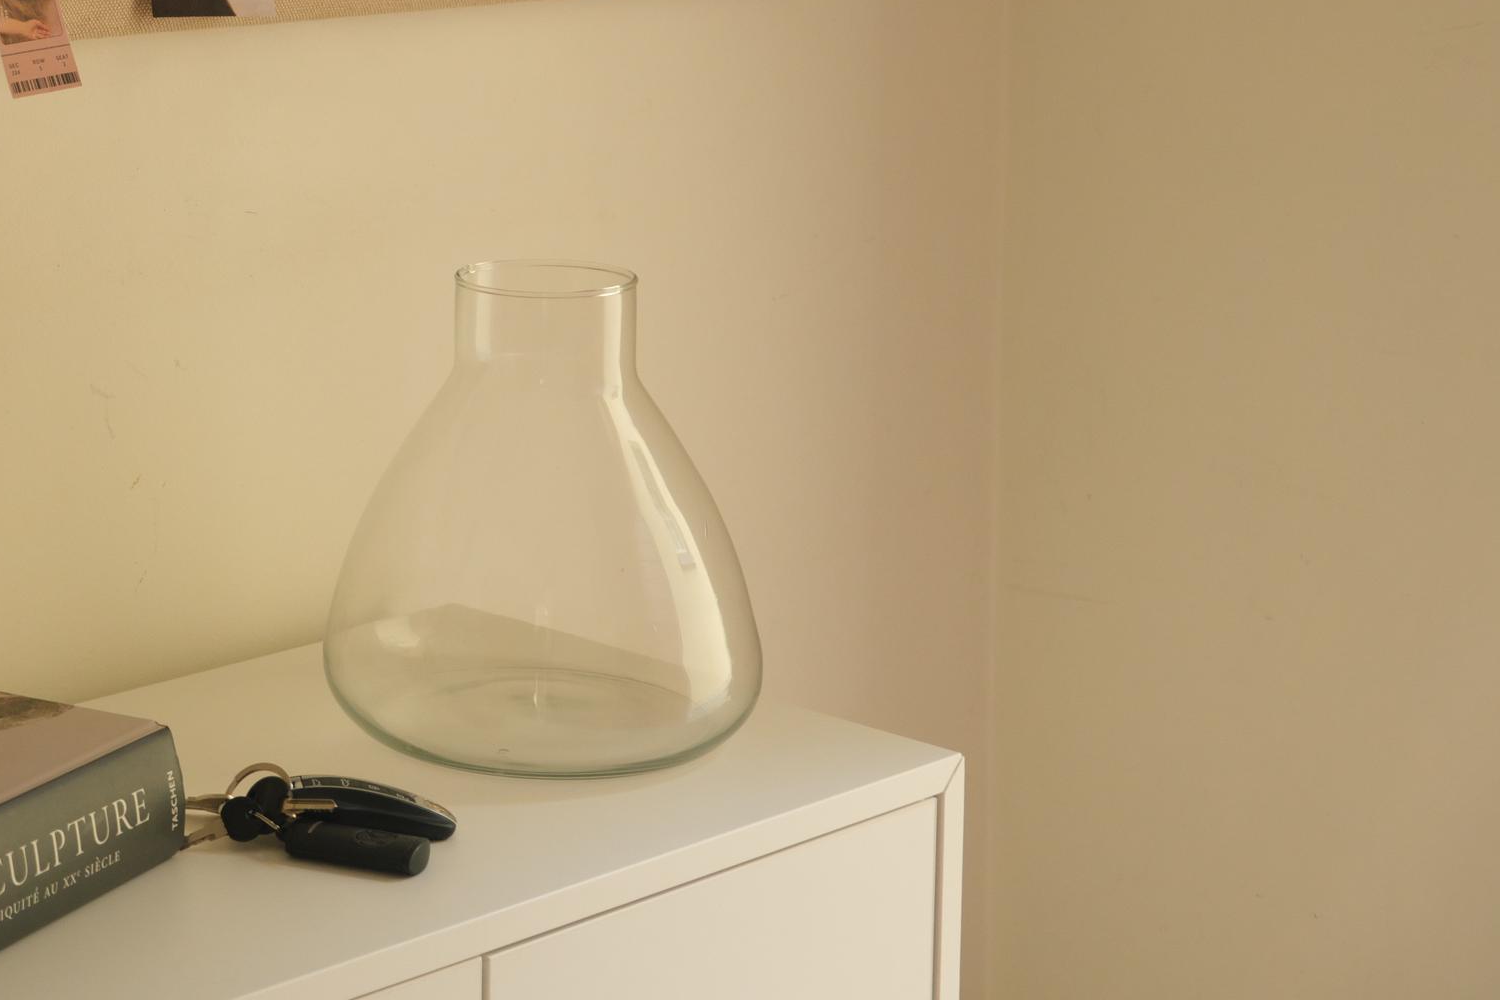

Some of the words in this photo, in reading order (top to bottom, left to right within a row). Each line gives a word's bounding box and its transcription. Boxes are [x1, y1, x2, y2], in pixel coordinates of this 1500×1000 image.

[167, 769, 180, 831] TASCHEN
[44, 881, 59, 900] AU
[84, 849, 121, 878] SIÈCLE
